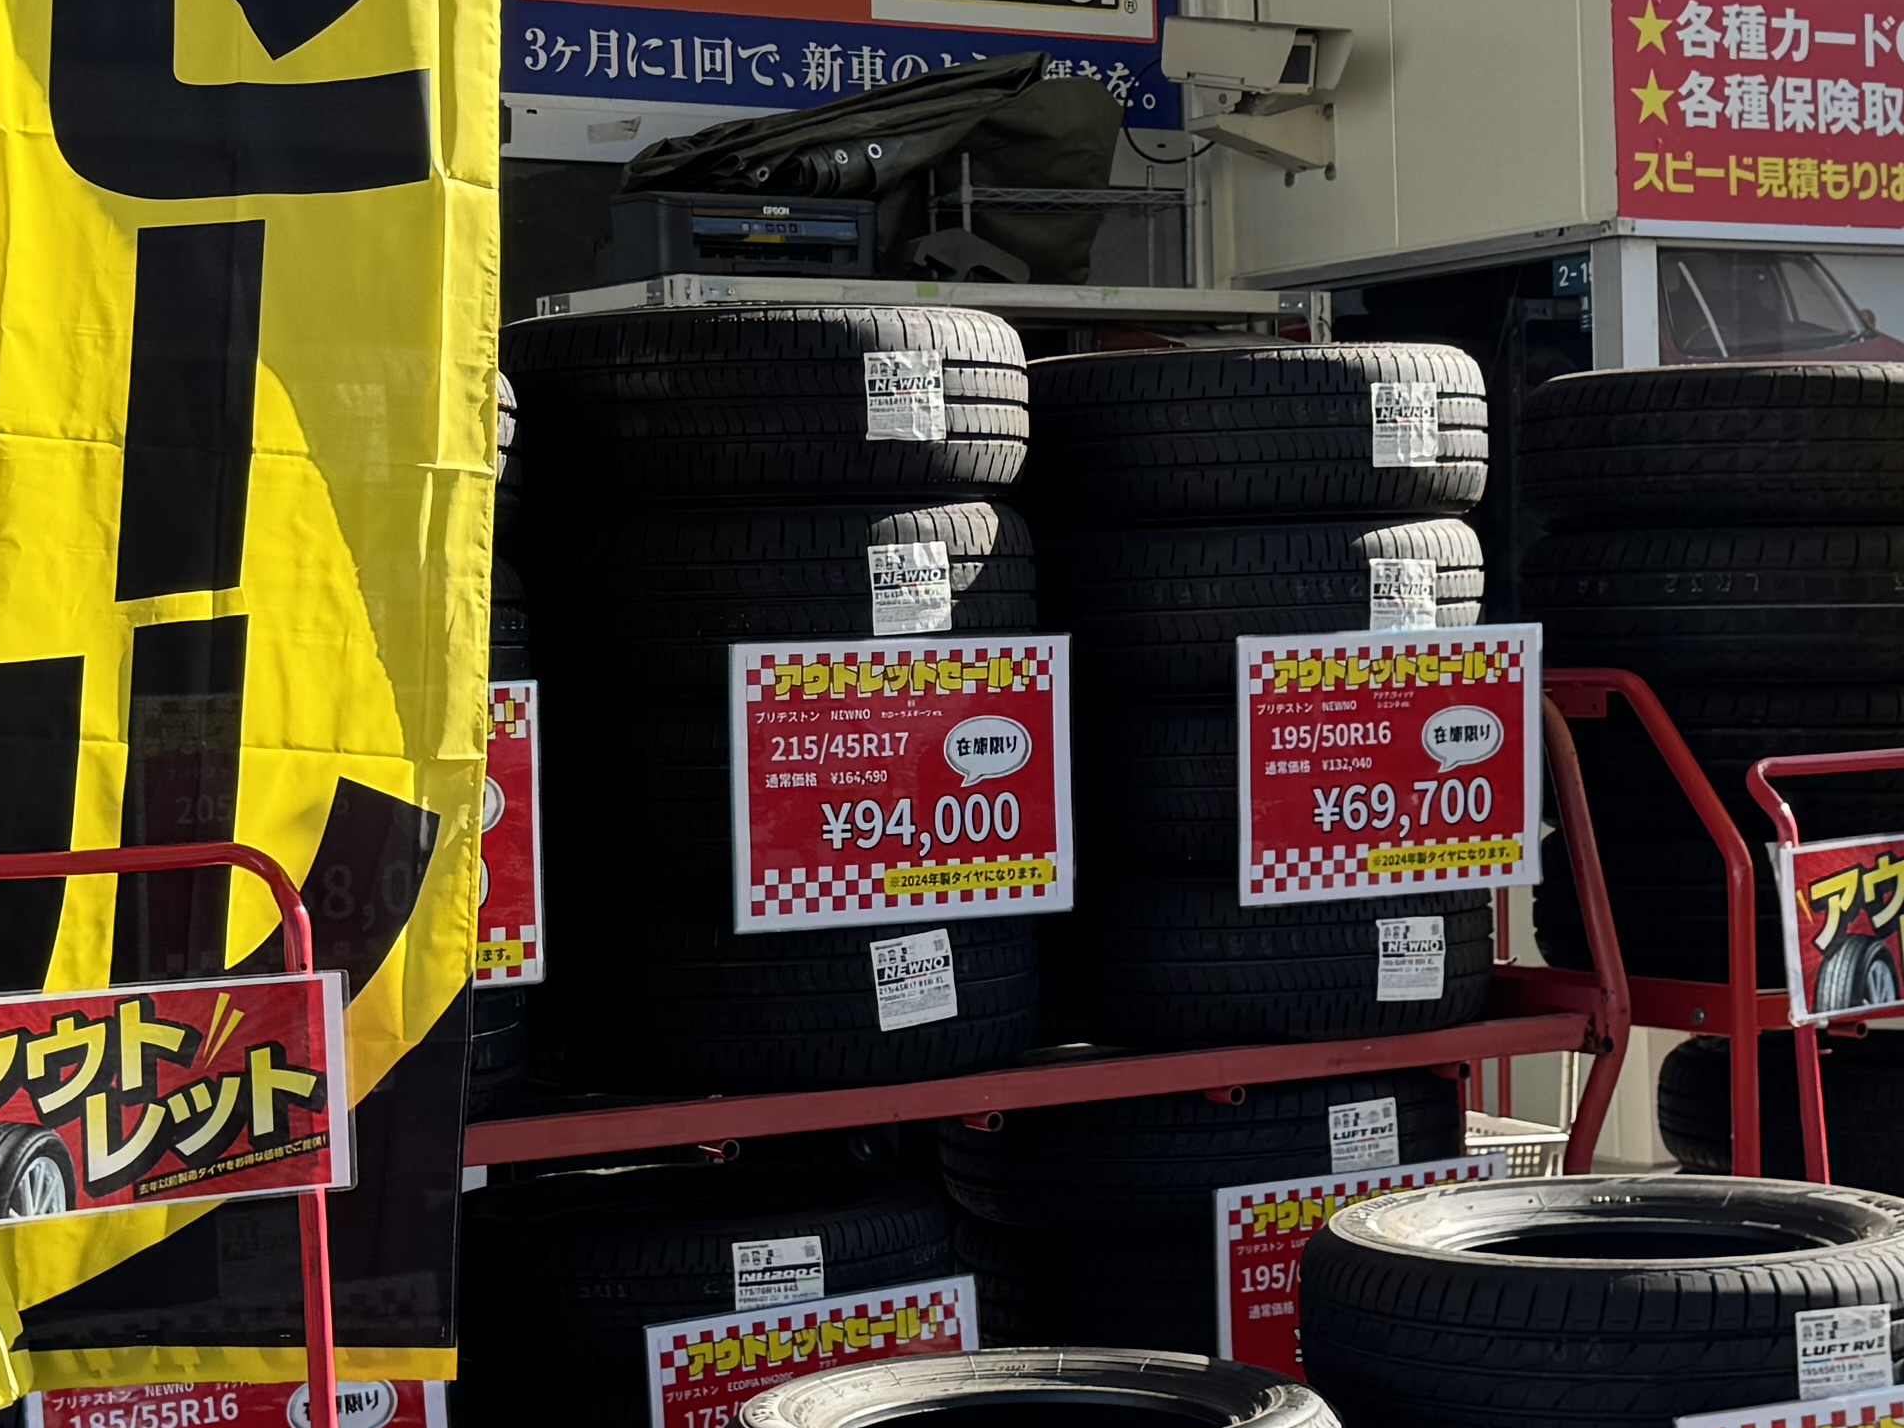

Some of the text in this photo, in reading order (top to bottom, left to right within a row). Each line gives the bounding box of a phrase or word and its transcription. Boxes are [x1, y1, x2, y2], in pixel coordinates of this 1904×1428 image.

[880, 567, 942, 584] NEWNO
[772, 655, 1032, 698] アウトレットセール!
[1272, 651, 1503, 689] アウトレットセール!
[770, 732, 910, 767] 215/45R17
[1270, 721, 1392, 755] 195/50R16
[765, 771, 817, 789] 通常価格
[820, 791, 1021, 856] ¥94,000
[1312, 777, 1493, 839] ¥69,700
[1387, 940, 1441, 952] NEWNO
[883, 956, 946, 982] NEWNO
[85, 1047, 317, 1182] レット
[1332, 1127, 1368, 1141] LUFT
[1801, 1343, 1849, 1358] LUFT
